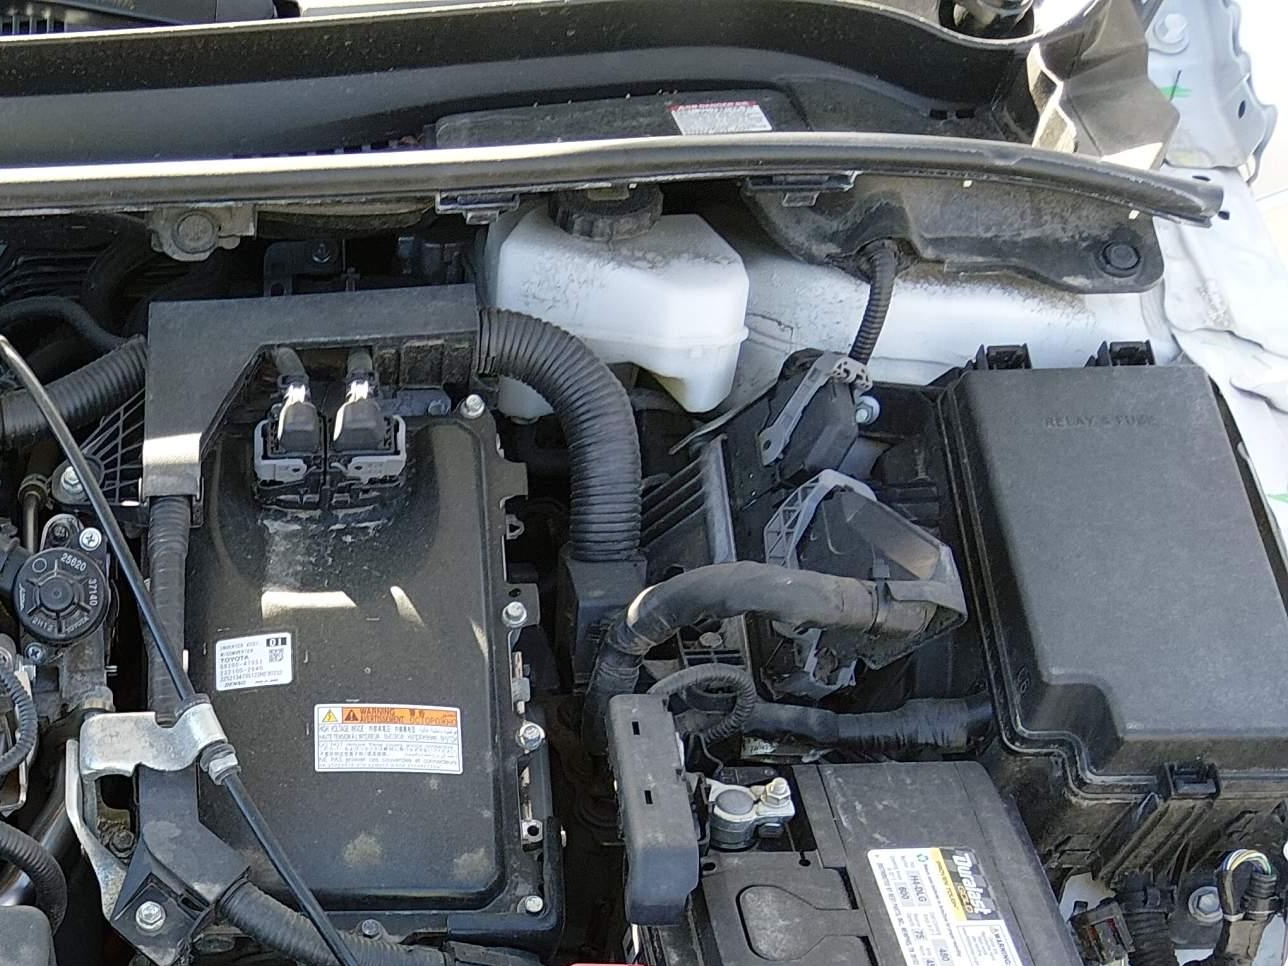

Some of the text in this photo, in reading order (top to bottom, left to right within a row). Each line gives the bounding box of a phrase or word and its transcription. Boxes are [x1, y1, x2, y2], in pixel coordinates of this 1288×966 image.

[61, 553, 87, 571] 25620
[908, 875, 927, 901] H4-DLG
[951, 853, 993, 914] Duralast
